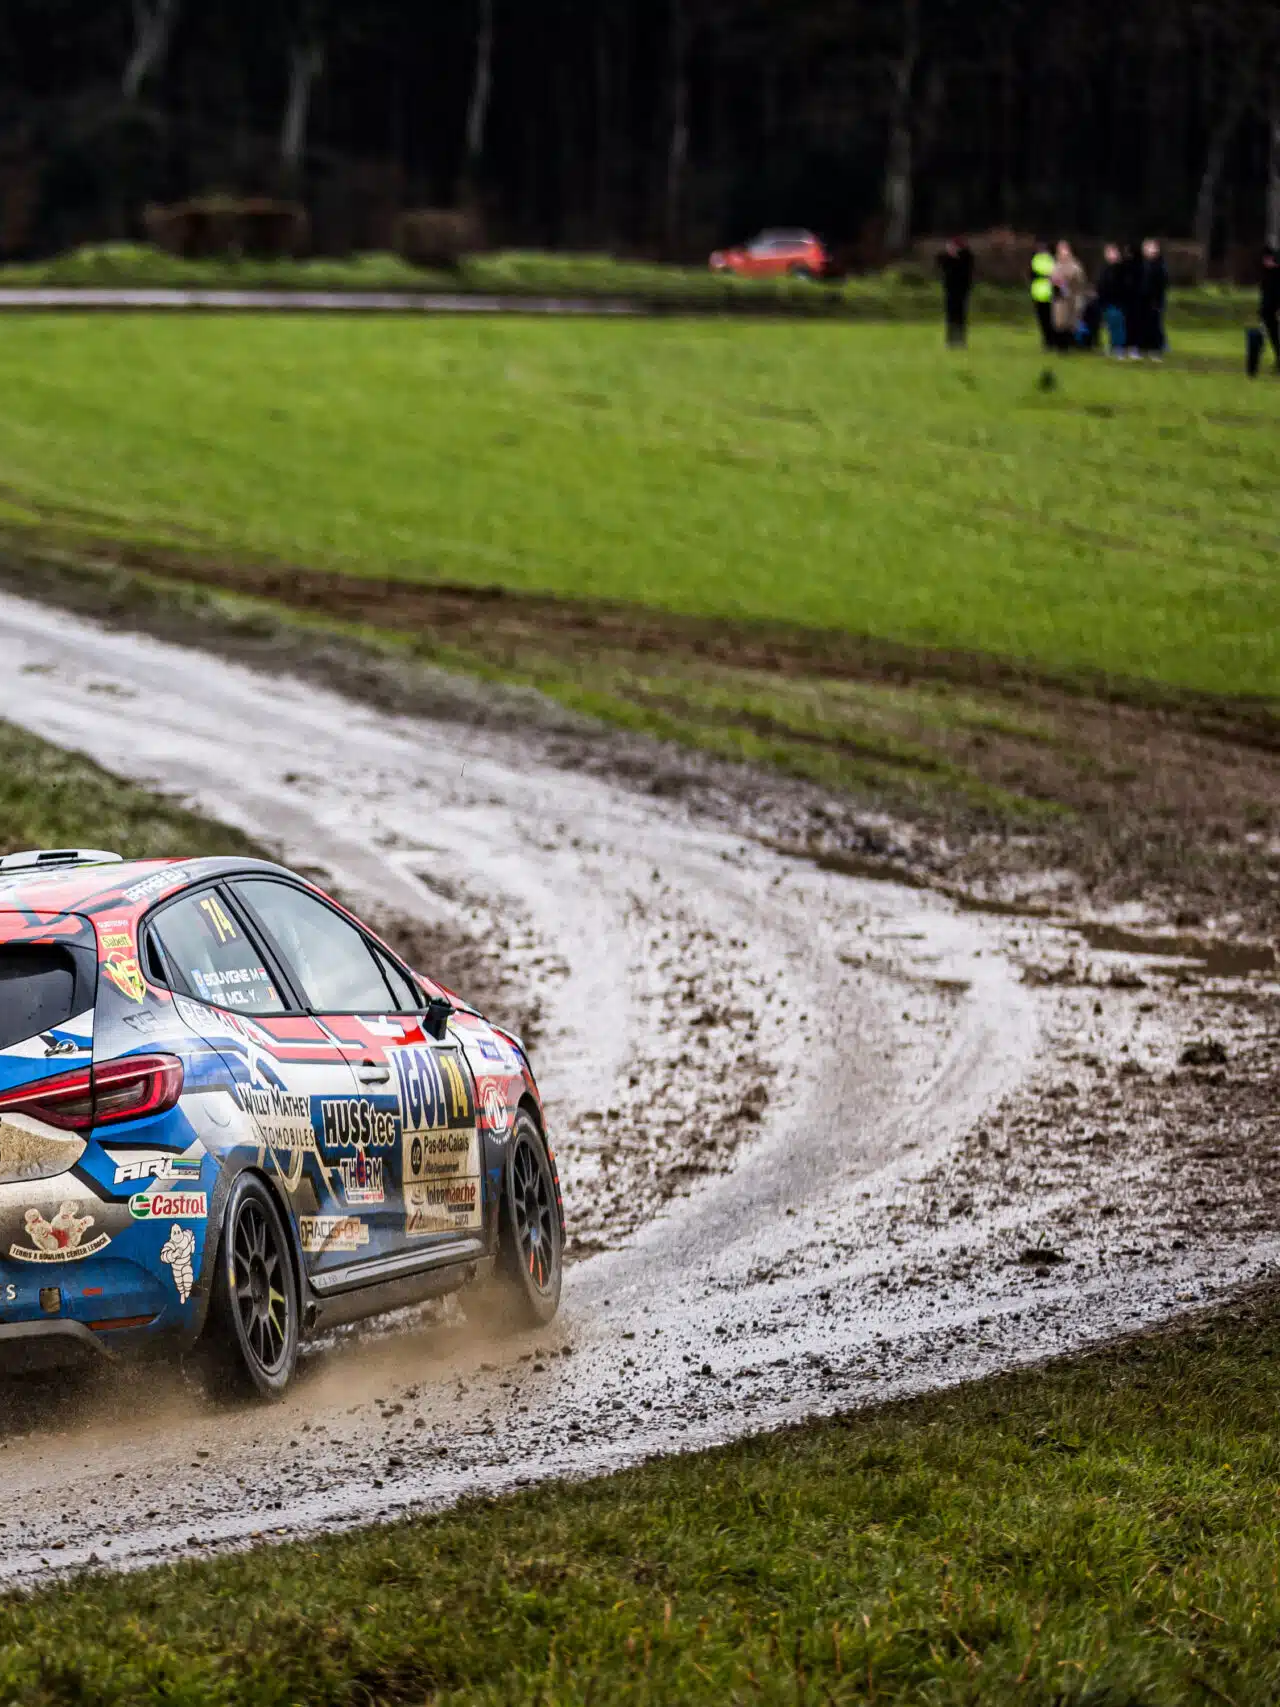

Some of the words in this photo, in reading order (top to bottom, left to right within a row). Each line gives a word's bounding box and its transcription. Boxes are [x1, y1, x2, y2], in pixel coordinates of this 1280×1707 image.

[200, 897, 236, 943] 74
[391, 1048, 447, 1130] IGOL
[439, 1055, 468, 1118] 74
[321, 1099, 396, 1147] HUSStec
[151, 1193, 206, 1217] Castrol
